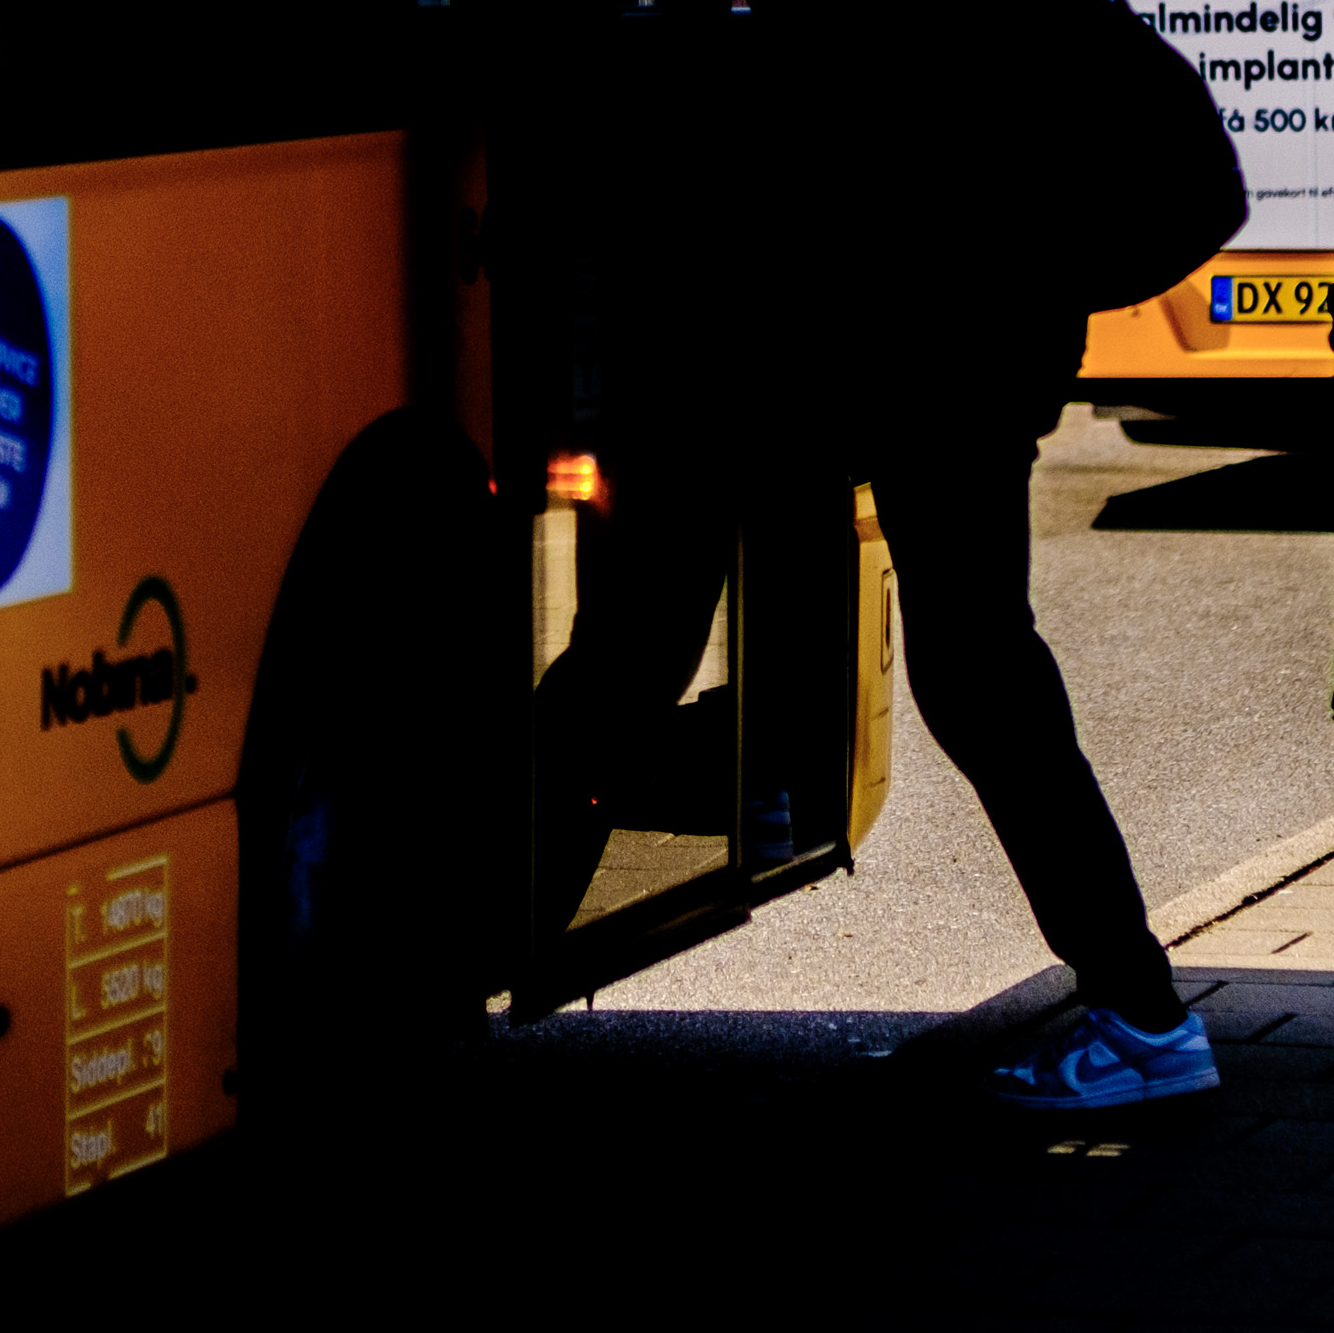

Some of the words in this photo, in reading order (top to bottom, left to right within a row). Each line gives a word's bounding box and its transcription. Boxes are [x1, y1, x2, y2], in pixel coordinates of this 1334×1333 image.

[1254, 108, 1306, 133] 500
[1256, 188, 1306, 201] gavekort
[1309, 186, 1319, 197] til
[1237, 281, 1283, 314] DX
[142, 957, 165, 1000] kg
